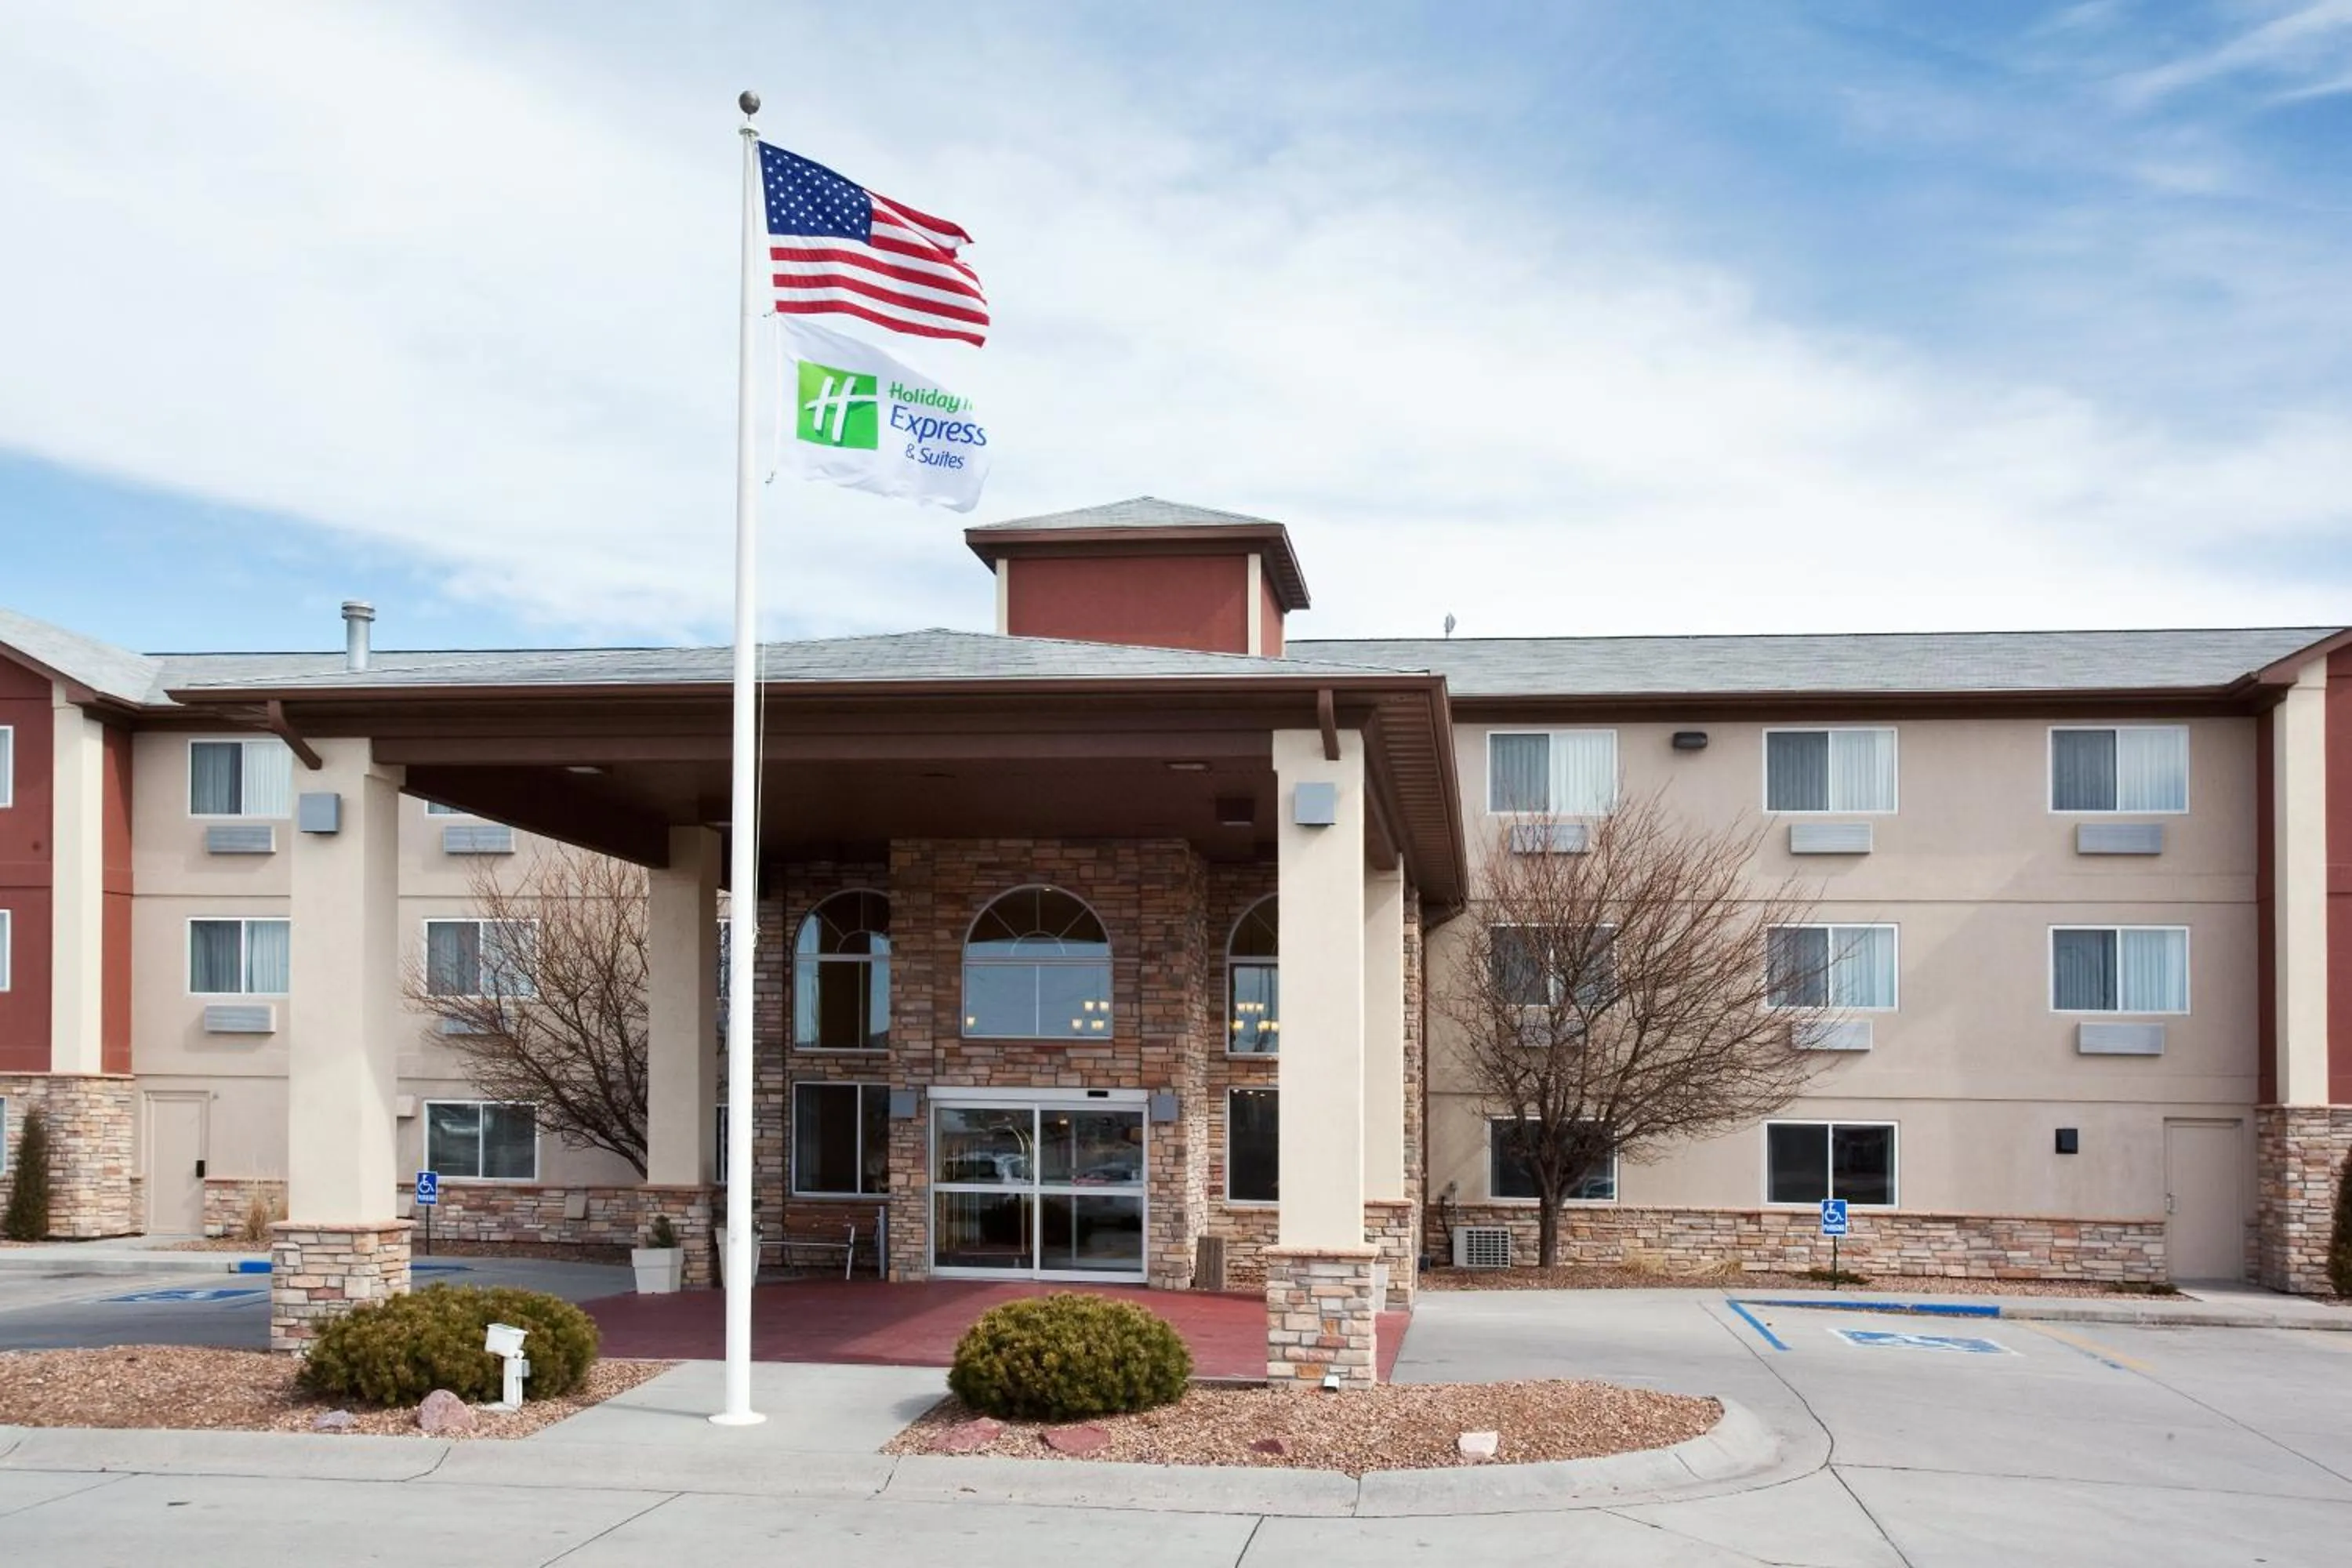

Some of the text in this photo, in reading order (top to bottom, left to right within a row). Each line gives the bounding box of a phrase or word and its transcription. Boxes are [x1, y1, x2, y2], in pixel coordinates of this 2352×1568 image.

[889, 381, 960, 414] Holiday
[890, 404, 987, 446] Express
[906, 443, 965, 470] & Suites
